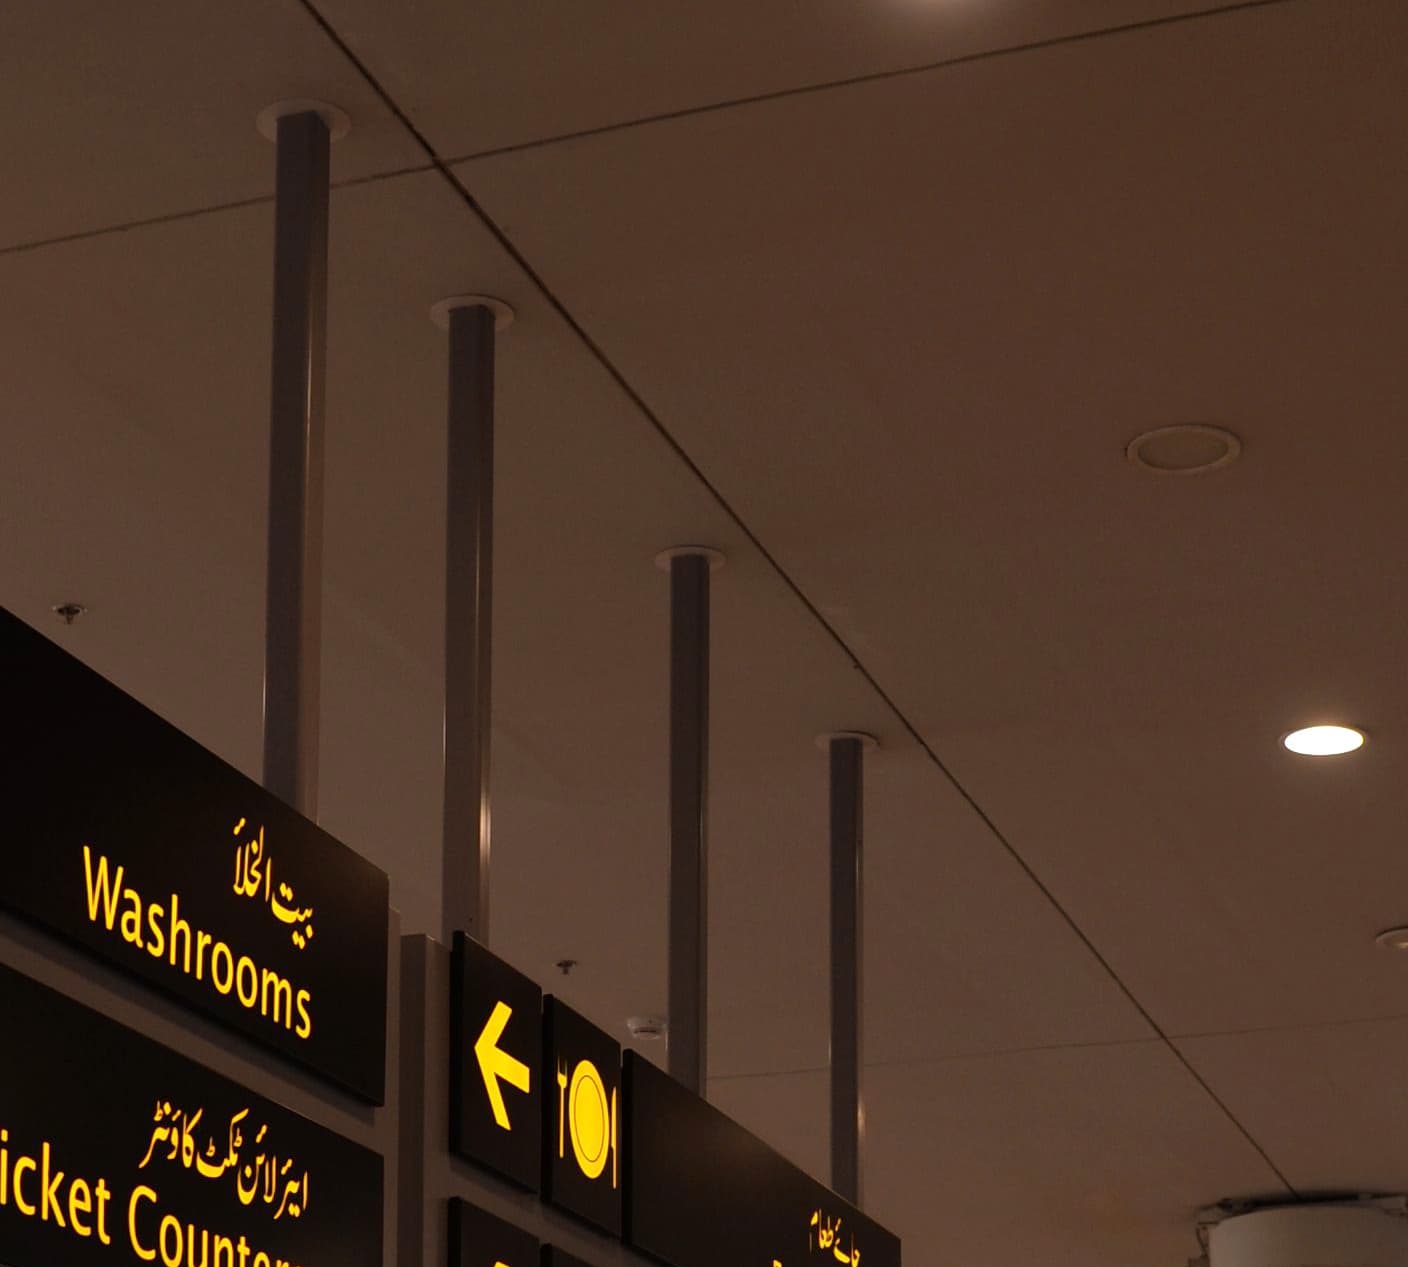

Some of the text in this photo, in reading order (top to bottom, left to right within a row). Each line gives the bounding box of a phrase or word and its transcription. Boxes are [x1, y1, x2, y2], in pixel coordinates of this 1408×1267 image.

[82, 844, 313, 1040] Washrooms
[271, 881, 315, 951] بیت
[195, 1107, 250, 1180] ٹکٹ
